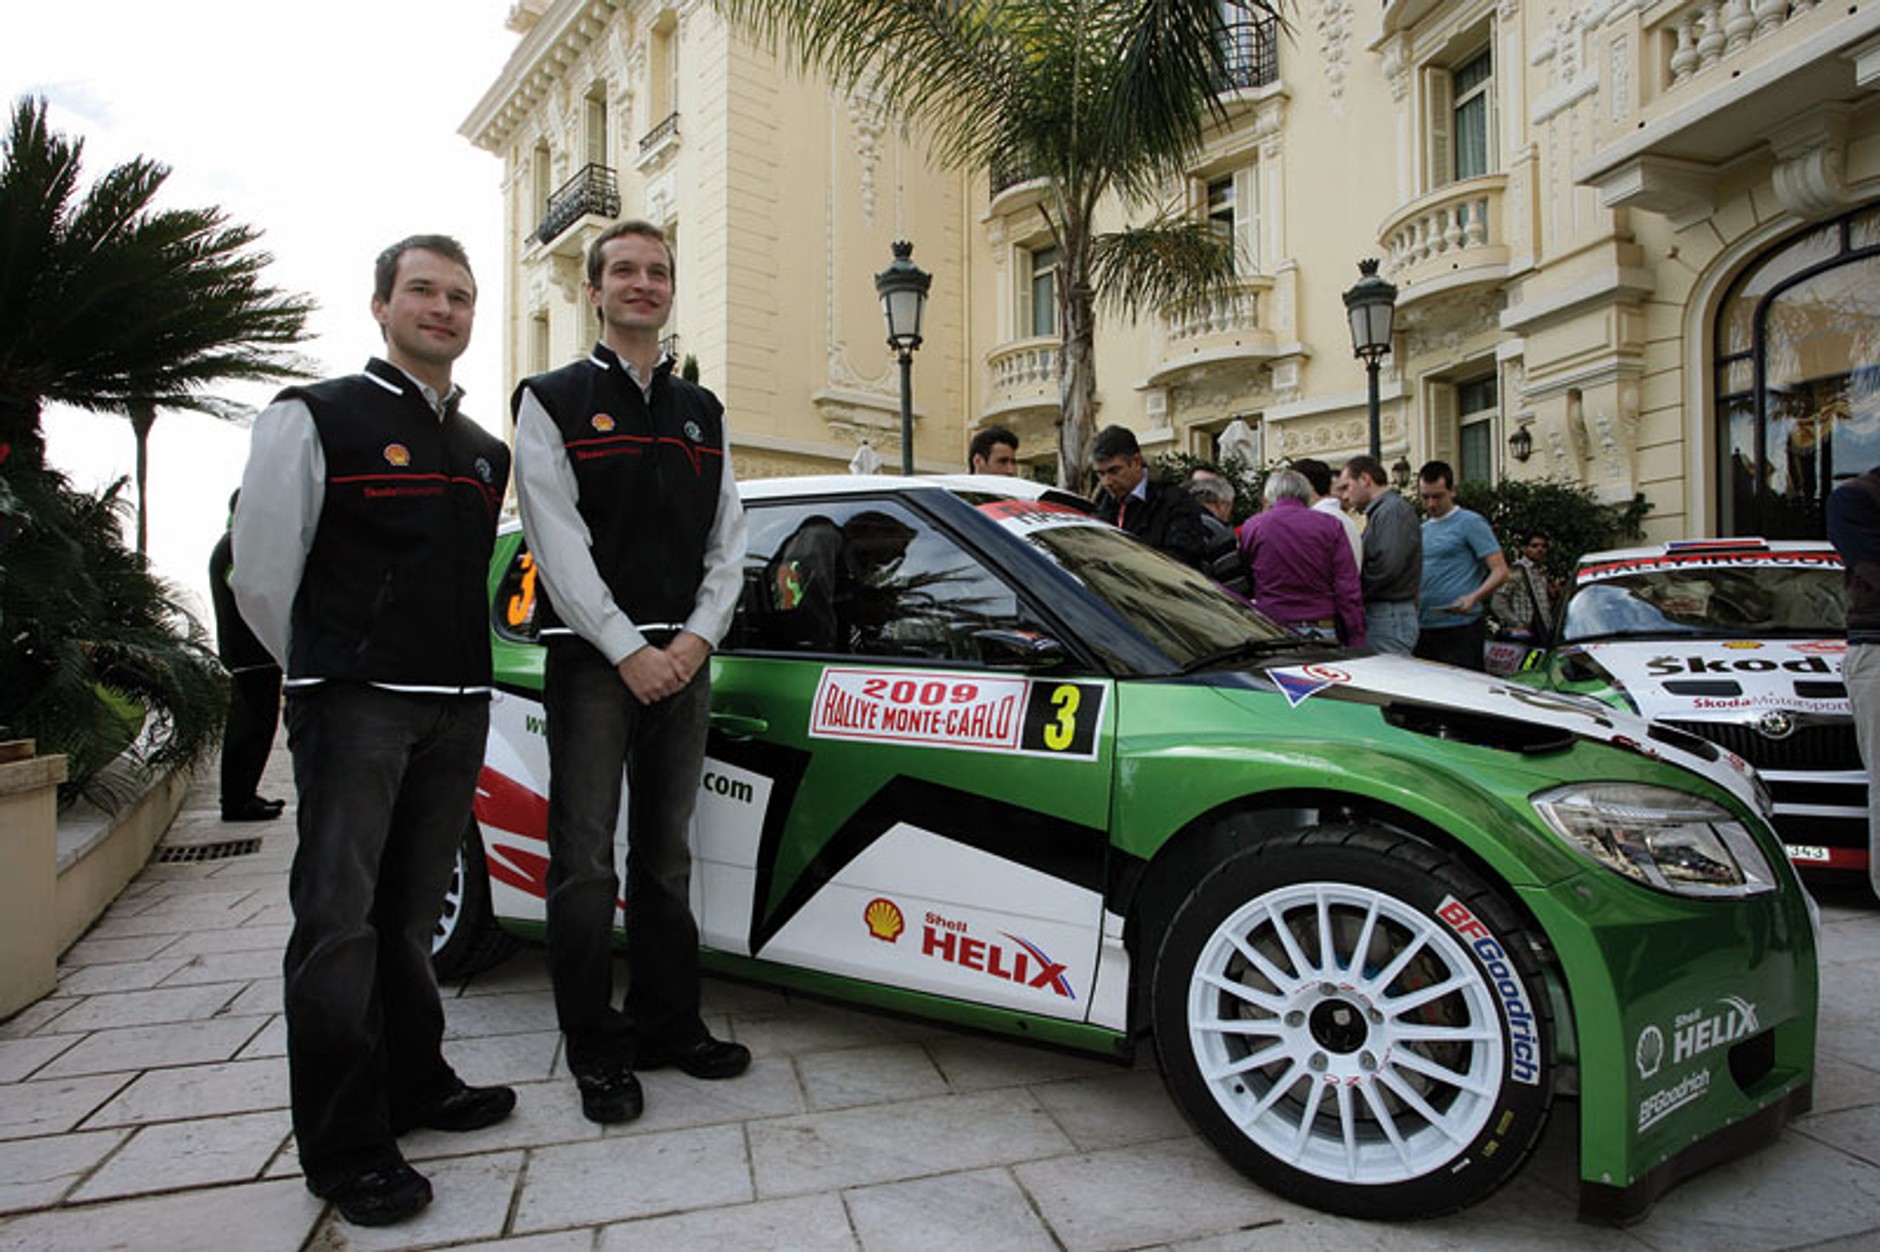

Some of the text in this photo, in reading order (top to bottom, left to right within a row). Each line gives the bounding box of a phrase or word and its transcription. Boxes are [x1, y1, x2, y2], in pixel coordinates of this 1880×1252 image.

[822, 682, 1015, 740] RALLYE MONTE-CARLO
[862, 678, 979, 706] 2009
[1043, 684, 1081, 751] 3
[924, 911, 968, 933] Shell
[921, 925, 1076, 1000] HELIX
[1438, 901, 1537, 1083] BFGoodrich
[1673, 996, 1759, 1064] HELIX
